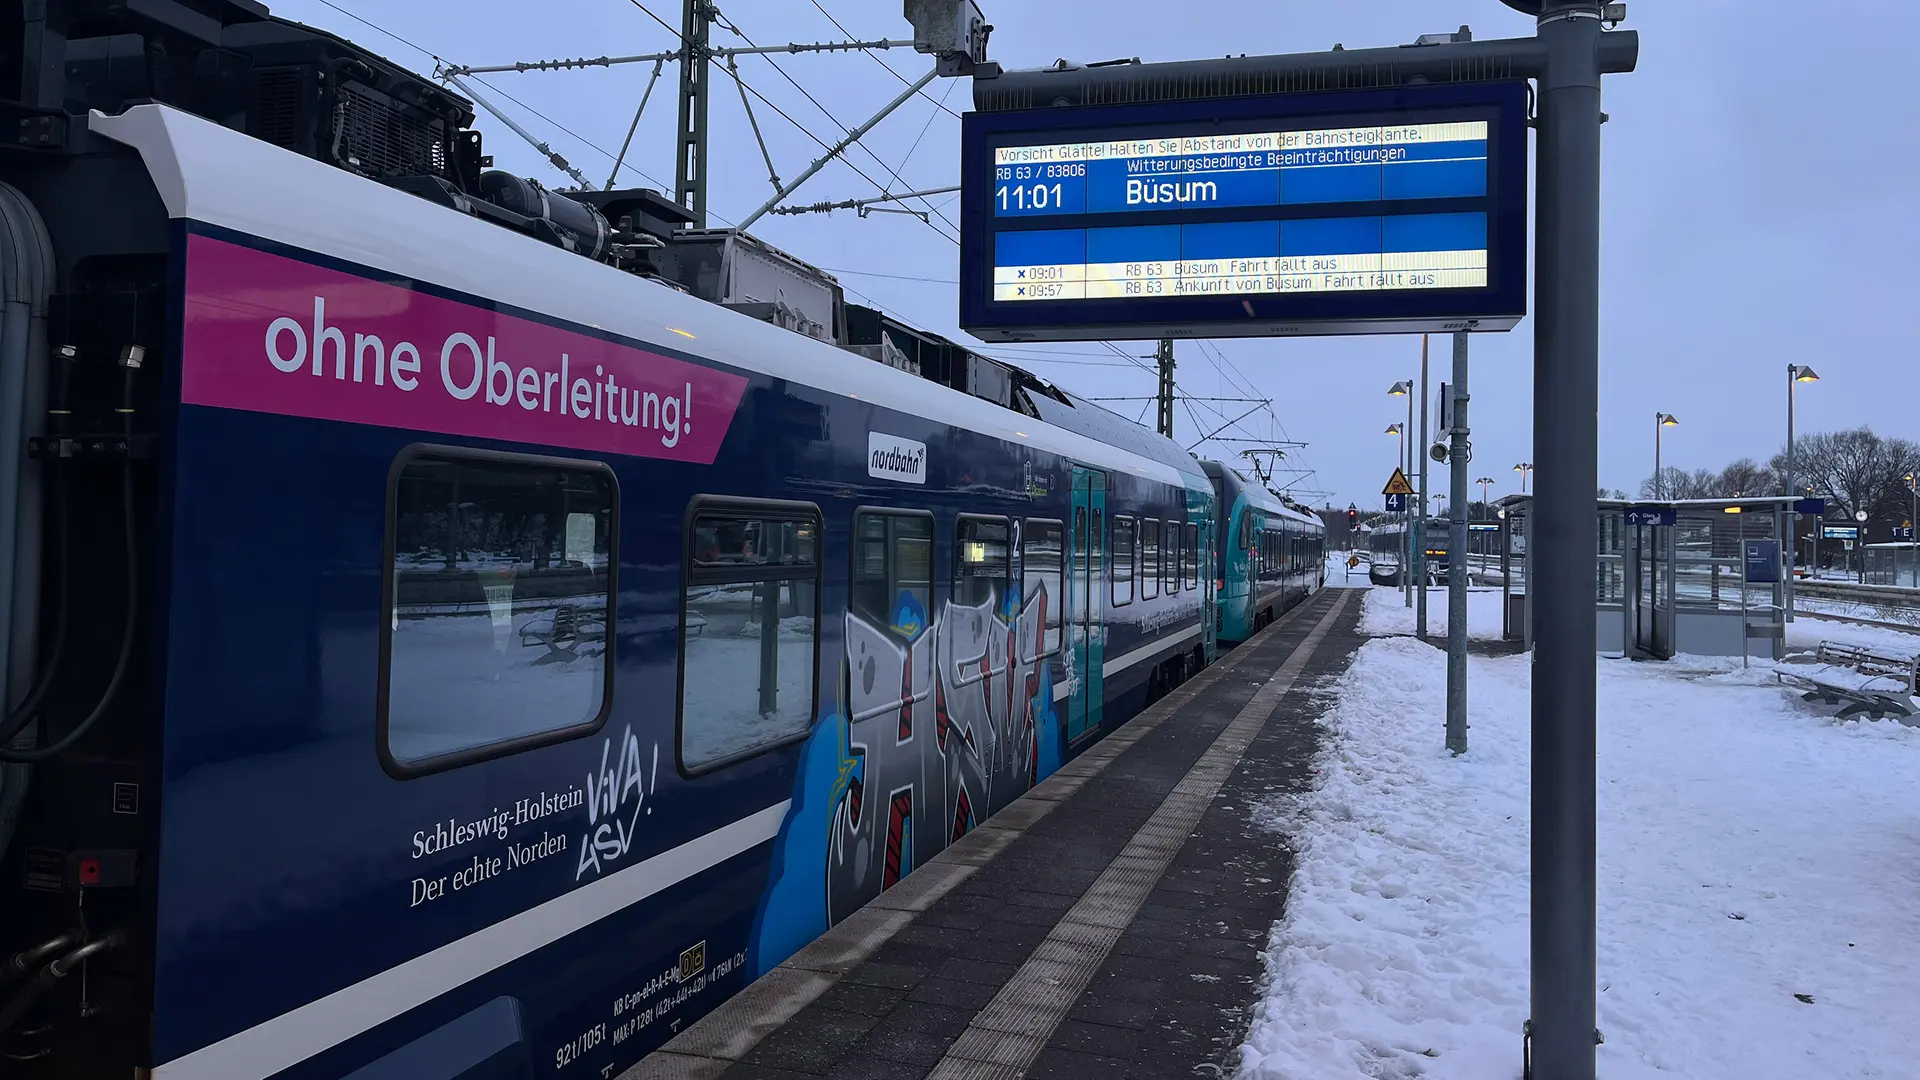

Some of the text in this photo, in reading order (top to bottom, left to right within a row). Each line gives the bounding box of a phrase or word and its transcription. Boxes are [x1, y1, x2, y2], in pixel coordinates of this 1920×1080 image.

[1000, 147, 1054, 162] Vorsicht
[1109, 142, 1154, 157] Halten
[1158, 141, 1178, 154] Sie
[1184, 137, 1241, 152] Abstand
[1246, 136, 1272, 149] von
[1276, 133, 1300, 148] der
[1305, 128, 1422, 146] Bahnsteigkante.
[996, 164, 1086, 180] RB 63 / 83806
[1126, 147, 1406, 173] Witterungsbedingte Beeinträchtigungen
[996, 183, 1062, 210] 11:01
[1126, 179, 1217, 204] Büsum
[1029, 267, 1064, 280] 09:01
[1126, 257, 1337, 277] RB 63 Büsum Fahrt fällt aus
[1029, 284, 1063, 297] 09:57
[1125, 282, 1142, 294] RB
[1146, 281, 1163, 293] 63
[1174, 278, 1230, 292] Ankunft
[1236, 279, 1261, 291] von
[1324, 274, 1364, 288] Fahrt
[1409, 273, 1435, 286] aus
[265, 295, 692, 448] ohne Oberleitung!
[871, 446, 919, 474] nordbahn
[1388, 494, 1399, 508] 4
[1013, 520, 1020, 557] 2
[411, 784, 583, 859] Schleswig-Holstein
[410, 831, 567, 908] Der echte Norden
[556, 1022, 607, 1069] 92t/105t
[613, 1023, 630, 1046] MAX:
[630, 1019, 636, 1035] P
